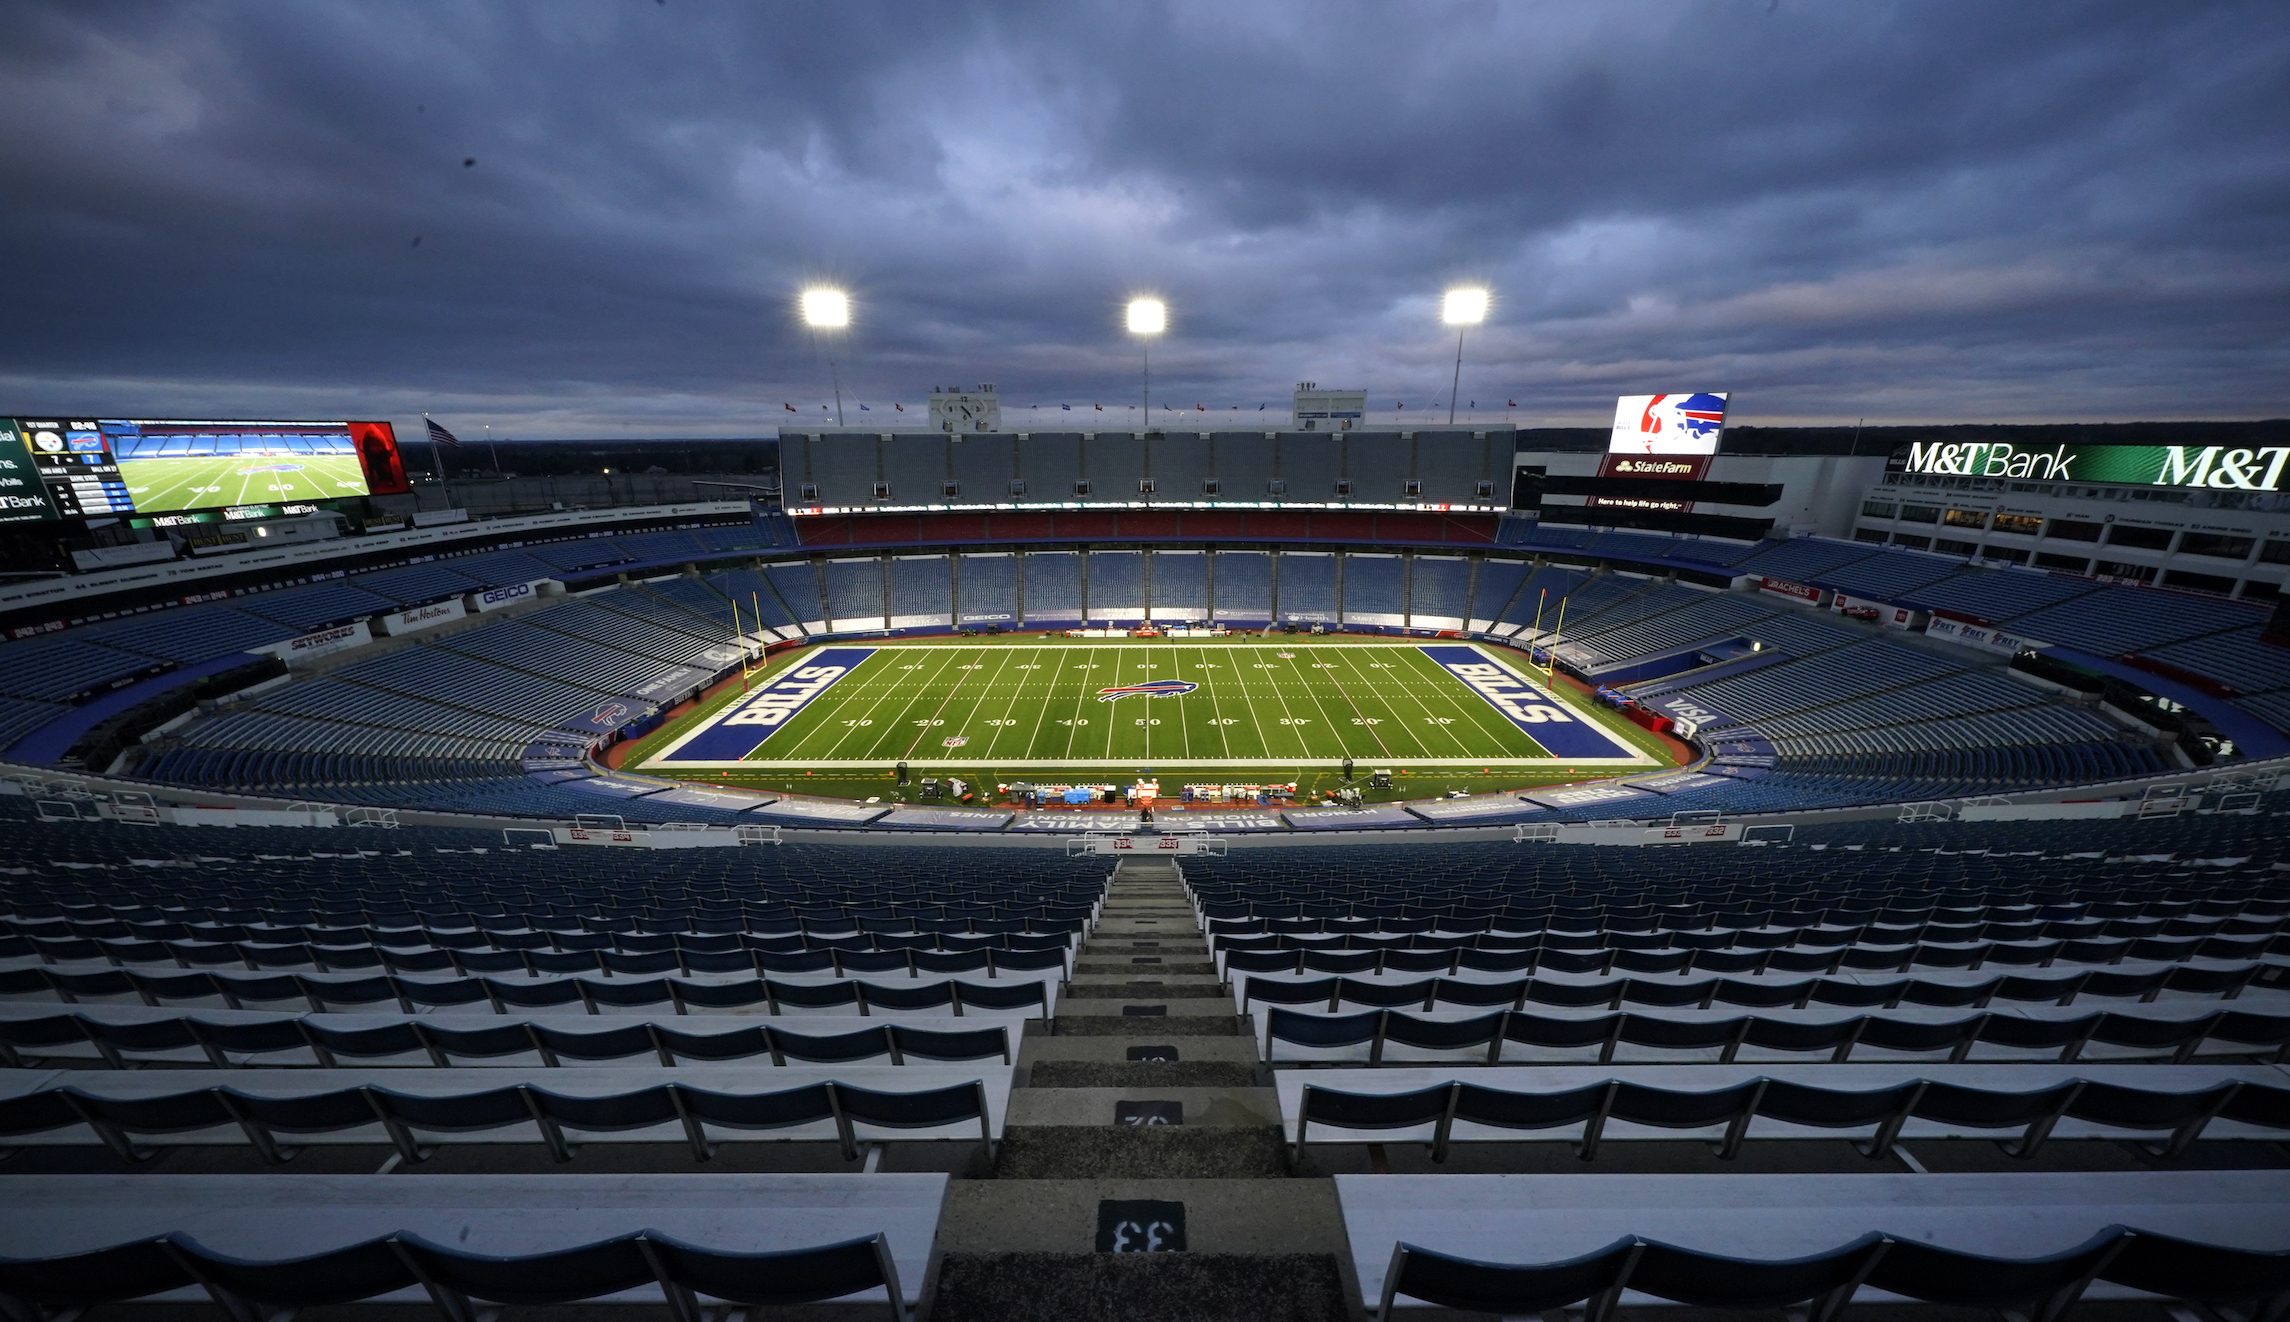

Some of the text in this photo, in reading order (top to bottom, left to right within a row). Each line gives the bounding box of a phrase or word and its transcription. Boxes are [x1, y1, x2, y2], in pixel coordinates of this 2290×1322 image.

[50, 455, 59, 465] 7
[86, 455, 94, 464] 7
[1623, 499, 1637, 508] help
[1650, 501, 1659, 509] go
[2121, 578, 2140, 587] 224
[1774, 580, 1811, 597] RACHEL'S
[483, 584, 529, 604] GEICO
[401, 606, 451, 625] Tim Hortons
[963, 613, 1010, 621] GEICO
[1296, 614, 1329, 622] Health
[1936, 619, 1957, 633] FREY
[1964, 625, 1987, 639] FREY
[292, 626, 355, 650] SKYWORKS
[1996, 633, 2020, 647] FREY
[722, 666, 847, 726] BILLS
[1446, 663, 1573, 724] BILLS
[1664, 697, 1718, 725] VISA
[848, 719, 873, 727] 10
[920, 719, 945, 727] 20
[990, 719, 1016, 727] 30
[1062, 719, 1089, 727] 40
[1135, 718, 1160, 726] 50
[1207, 718, 1233, 726] 40
[1279, 718, 1304, 726] 30
[1351, 718, 1376, 726] 20
[1424, 718, 1449, 726] 10
[949, 811, 1005, 819] LINES
[1292, 808, 1379, 818] HONORS
[1027, 814, 1093, 822] FRONT
[1018, 820, 1279, 829] BILLS FAMILY
[1707, 826, 1724, 835] 332
[1160, 838, 1177, 848] 333
